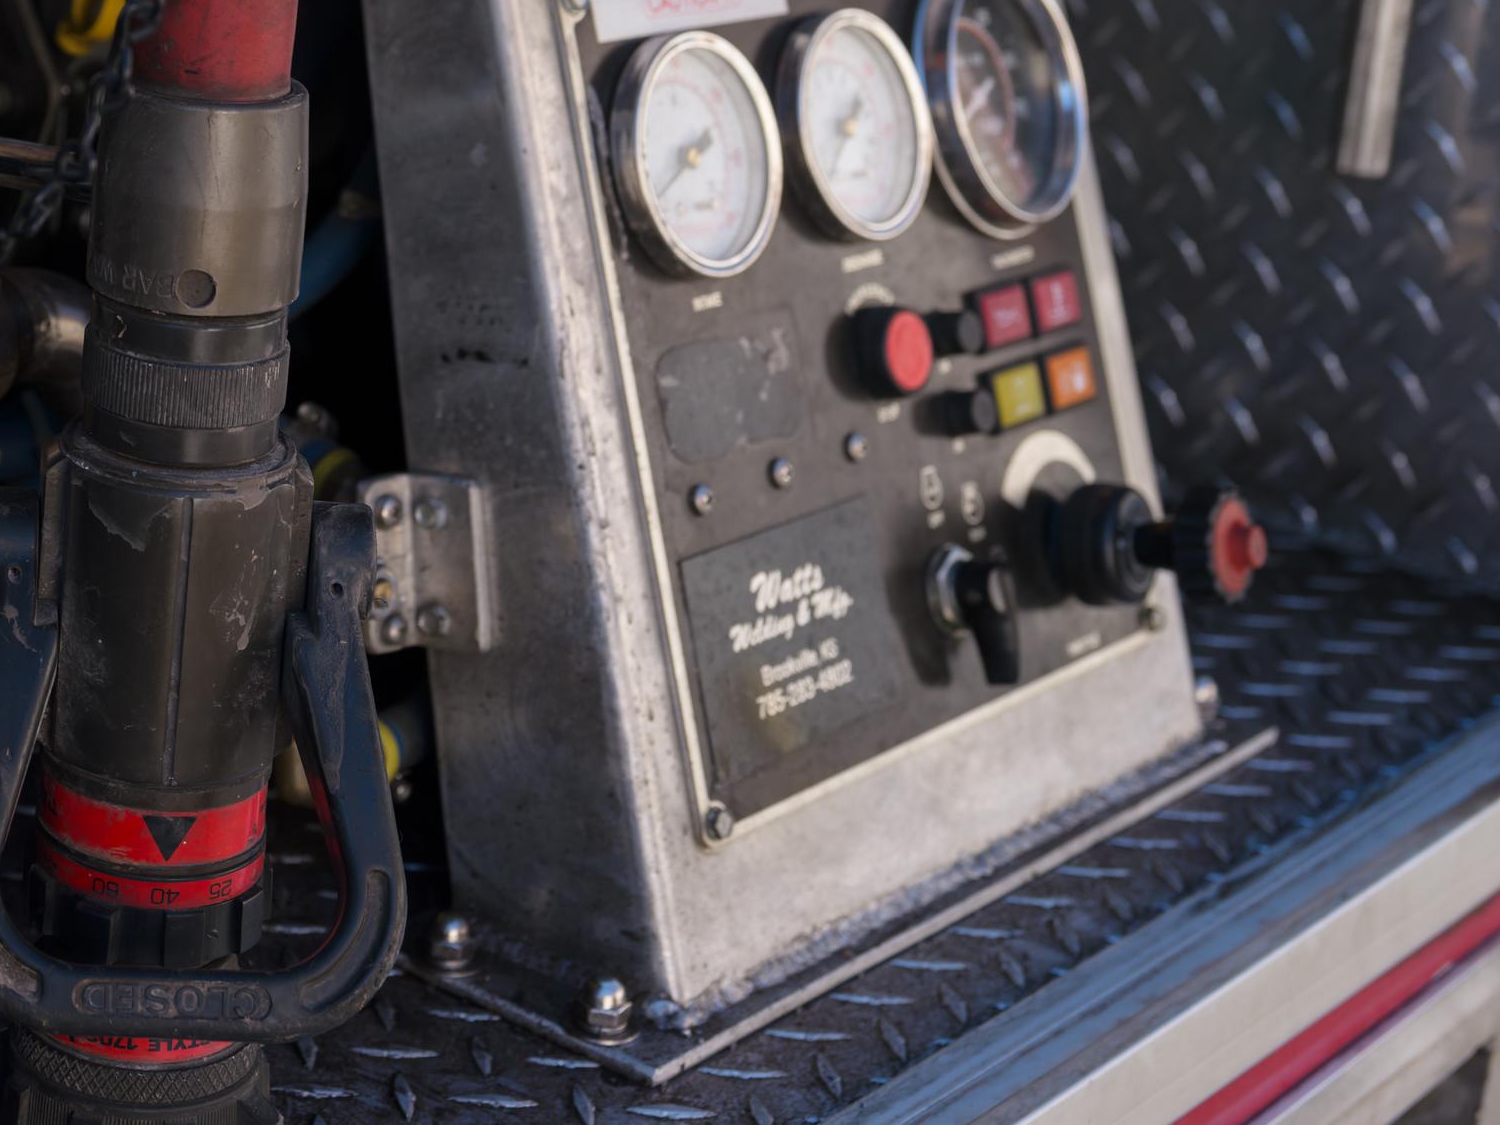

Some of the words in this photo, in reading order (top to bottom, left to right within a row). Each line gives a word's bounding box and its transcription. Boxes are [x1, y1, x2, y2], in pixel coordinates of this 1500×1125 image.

[150, 888, 180, 905] 40
[209, 879, 232, 900] 25
[83, 982, 258, 1020] CLOSED
